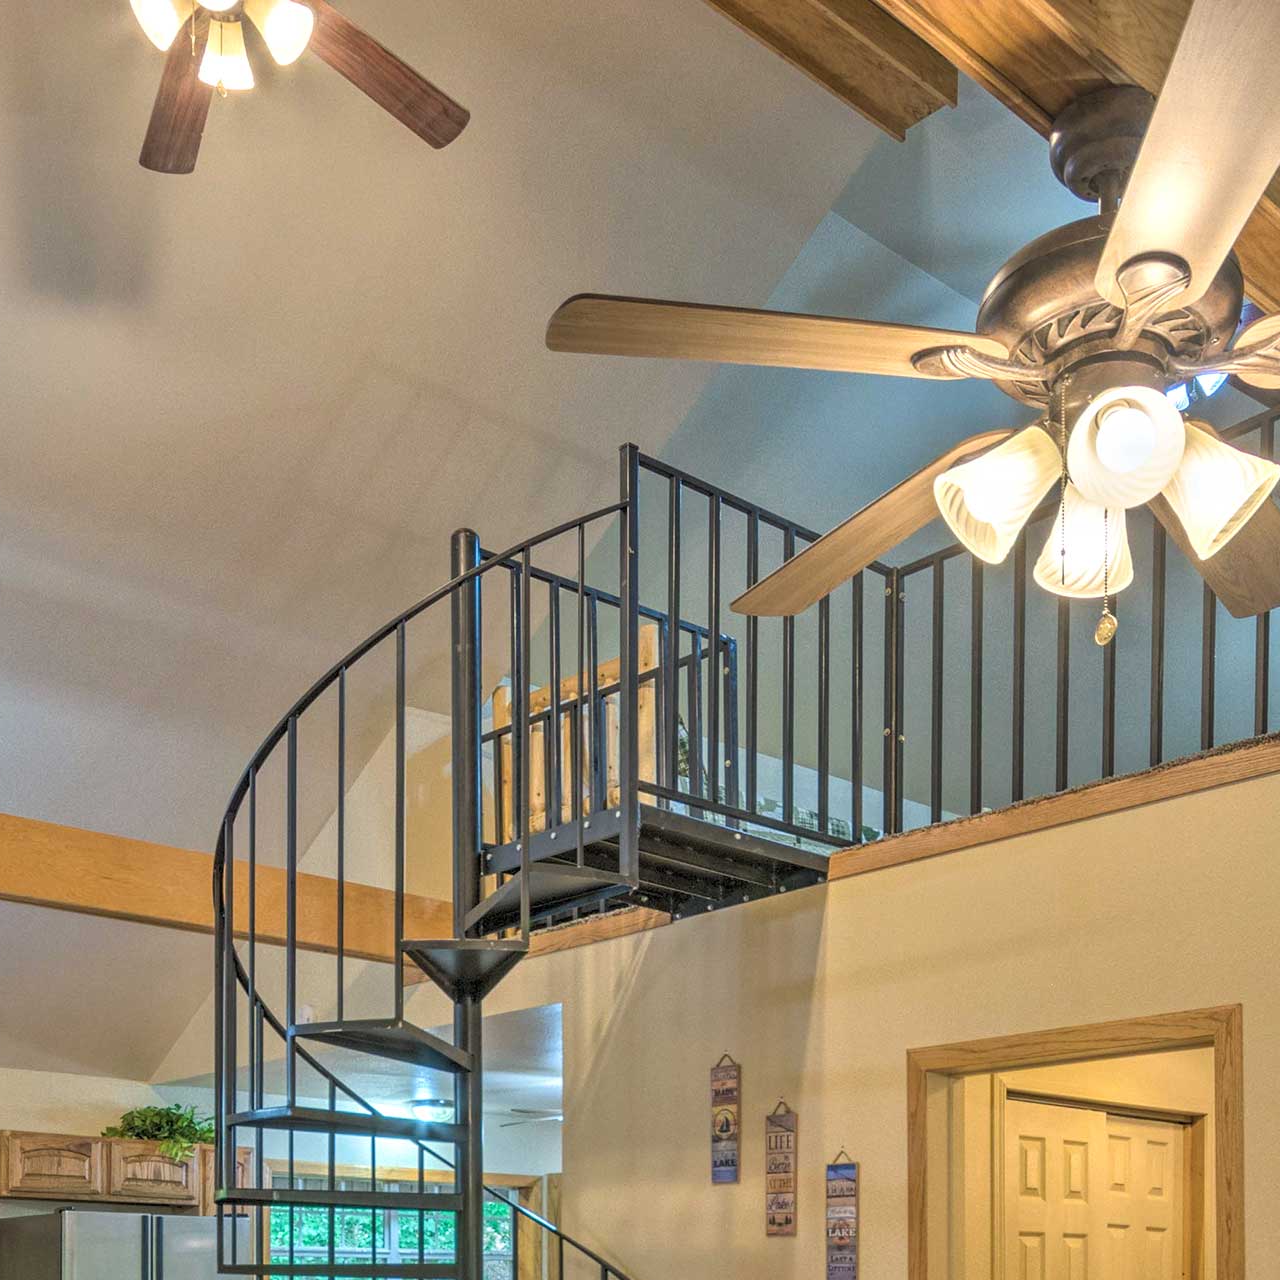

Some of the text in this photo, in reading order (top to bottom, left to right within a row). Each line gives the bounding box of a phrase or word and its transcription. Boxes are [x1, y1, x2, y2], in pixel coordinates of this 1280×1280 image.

[768, 1135, 792, 1150] LIFE
[713, 1158, 737, 1168] LAKE
[828, 1228, 856, 1237] LAKE
